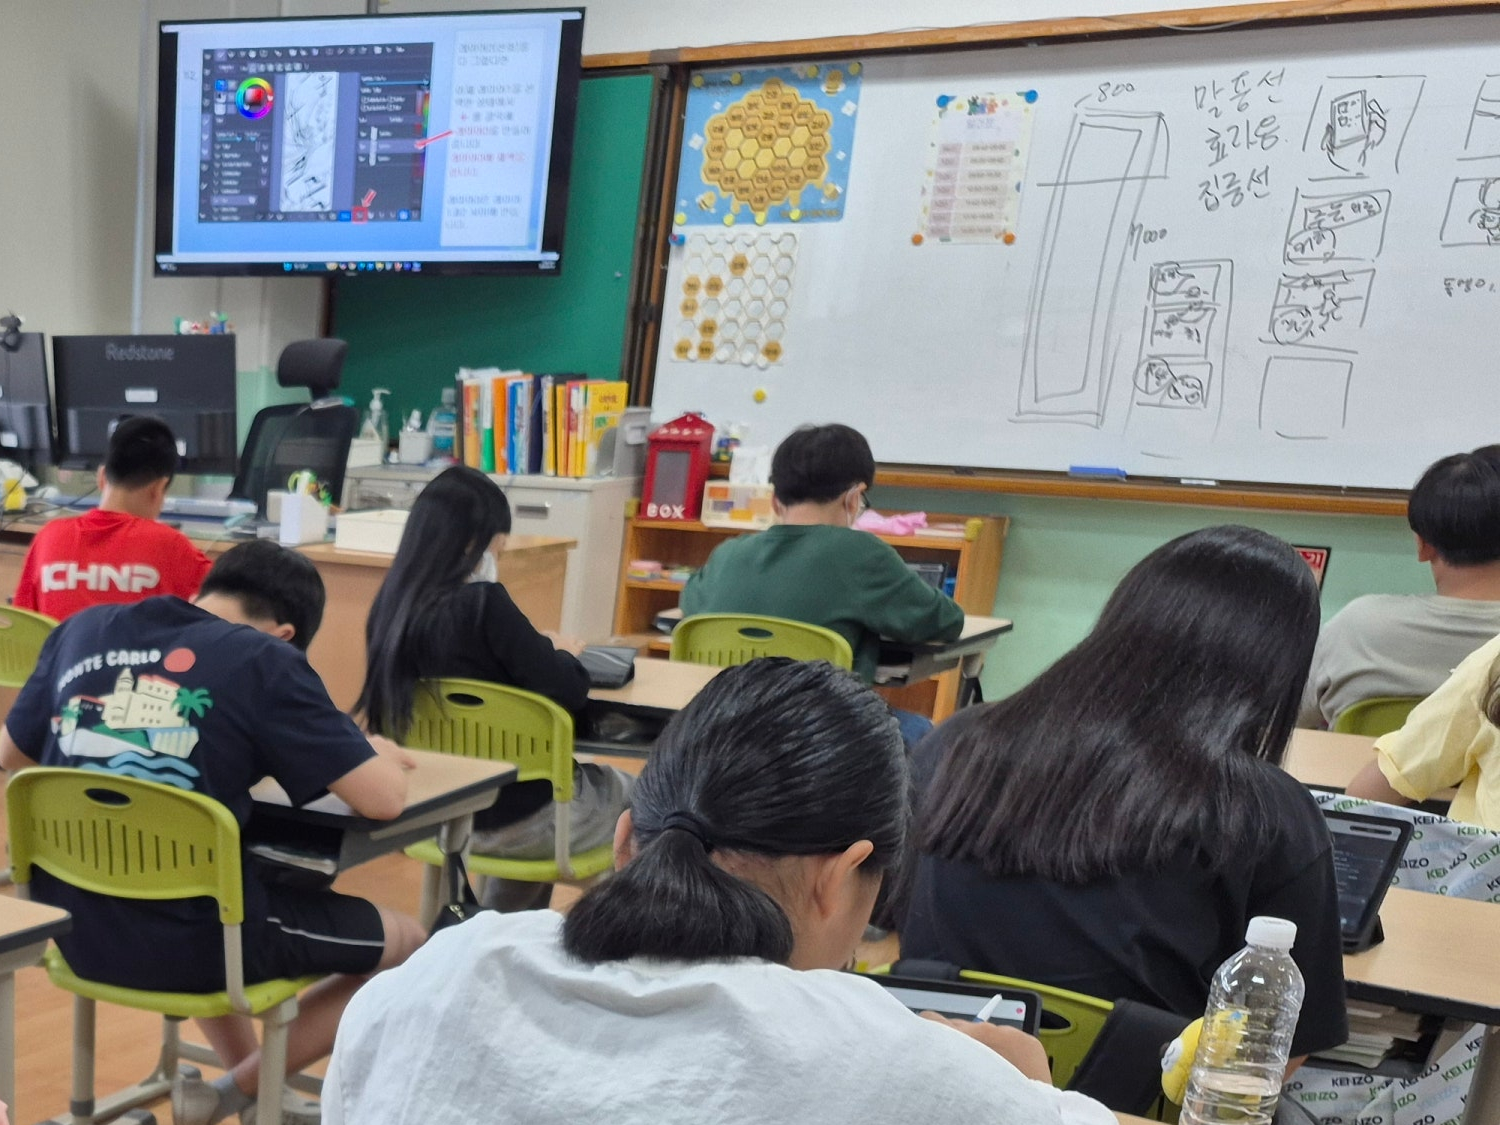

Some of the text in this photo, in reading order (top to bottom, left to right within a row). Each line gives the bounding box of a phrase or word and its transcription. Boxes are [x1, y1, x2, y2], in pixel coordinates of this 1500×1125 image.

[1098, 82, 1135, 102] 800
[1194, 67, 1286, 118] 말풍선
[1198, 165, 1271, 212] 집중선
[646, 502, 685, 519] BOX
[106, 648, 161, 667] CARLO
[1469, 843, 1500, 870] KENZ
[1441, 1056, 1480, 1082] KENZ
[1331, 1074, 1374, 1088] KENZO
[1301, 1091, 1339, 1102] KENZO
